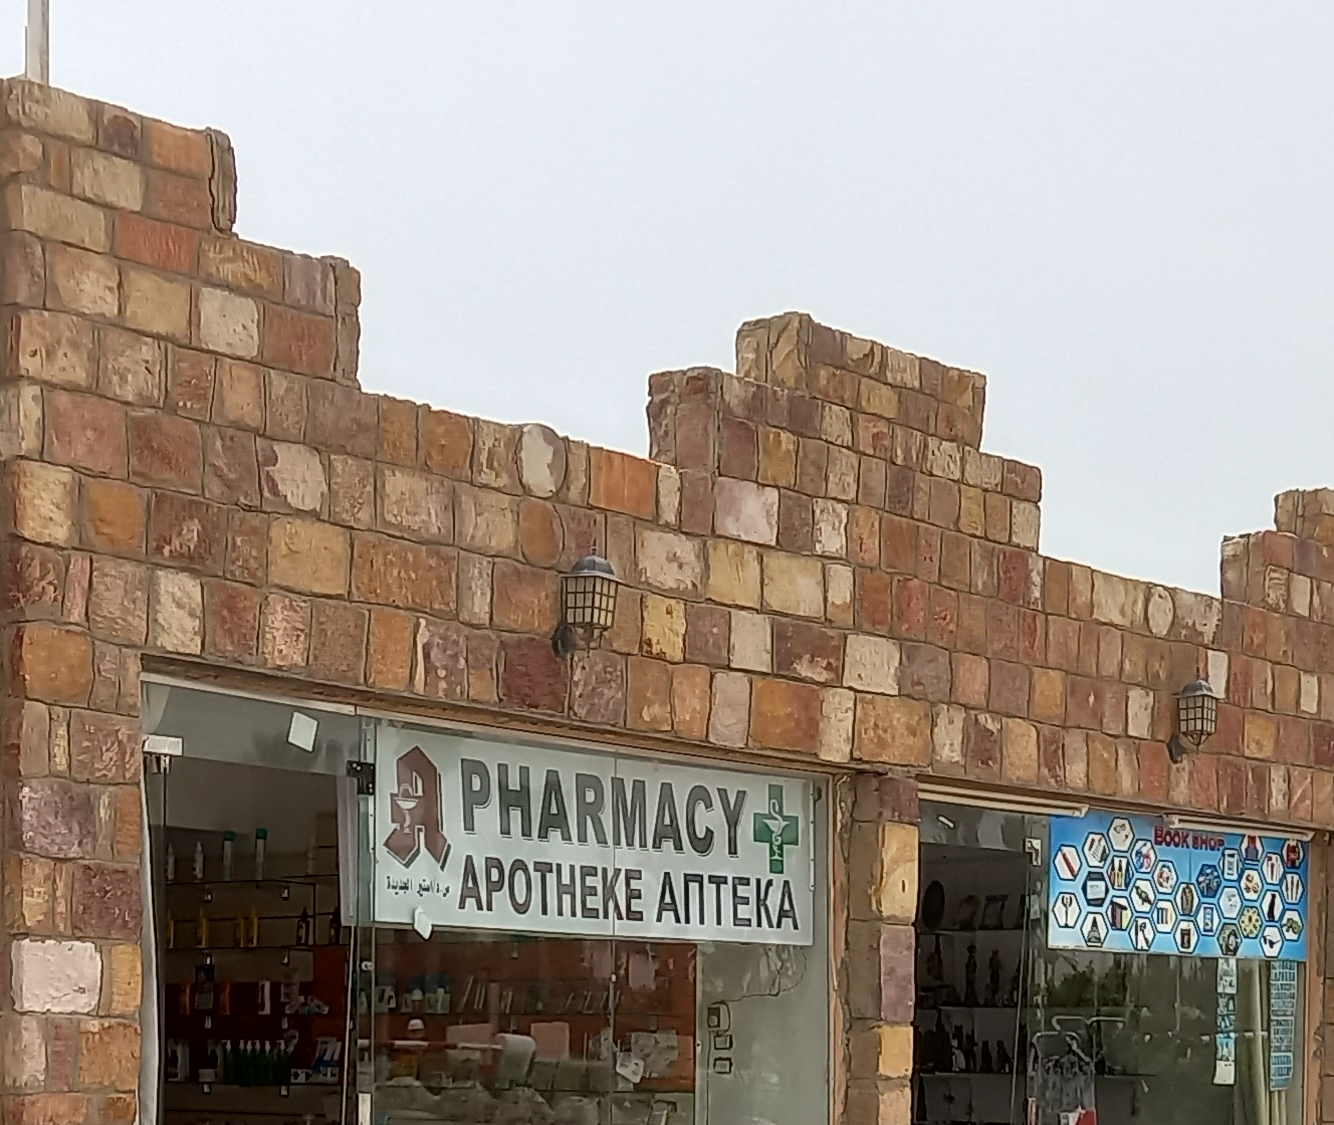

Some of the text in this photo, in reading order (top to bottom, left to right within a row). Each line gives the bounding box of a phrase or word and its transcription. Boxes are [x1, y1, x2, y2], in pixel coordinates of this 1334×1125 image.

[460, 757, 747, 858] PHARMACY
[457, 854, 800, 931] APOTHEKE АПТЕКА
